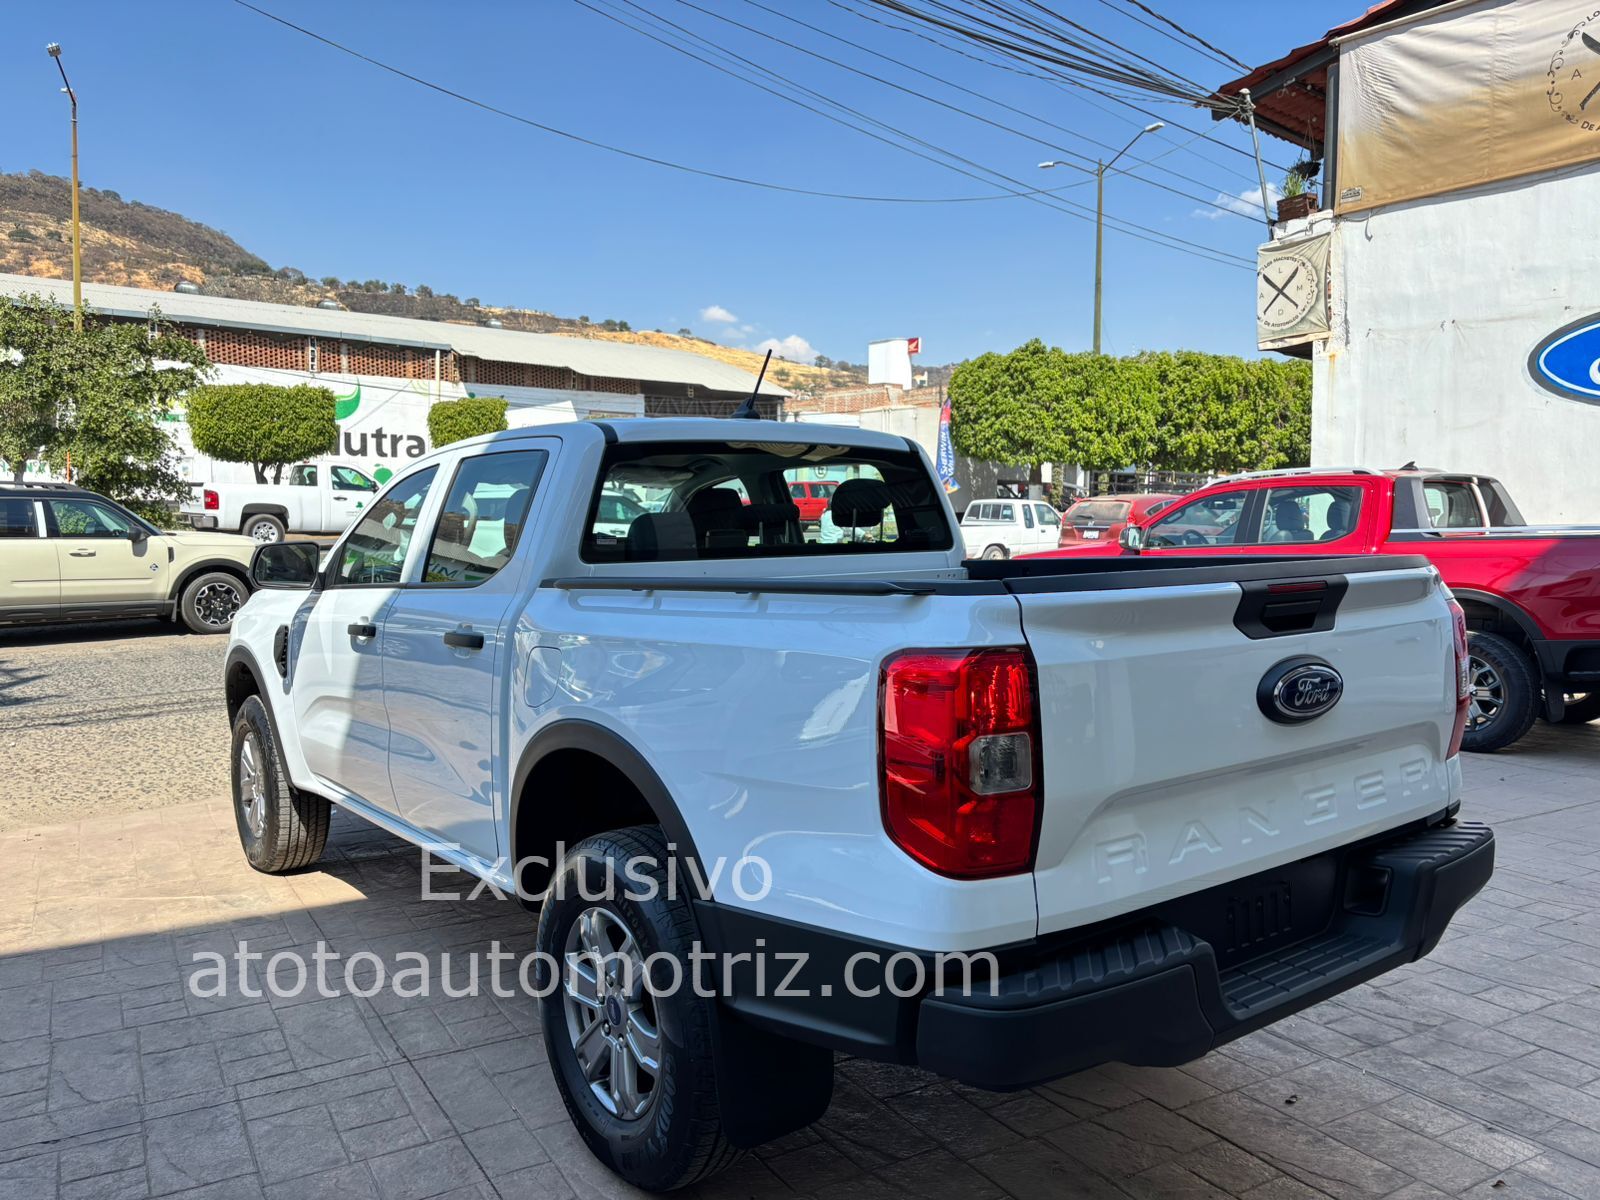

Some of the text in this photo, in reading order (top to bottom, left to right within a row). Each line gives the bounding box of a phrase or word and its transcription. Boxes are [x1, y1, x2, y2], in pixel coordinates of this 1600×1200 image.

[1571, 68, 1582, 81] A
[1294, 677, 1330, 706] Ford
[1094, 757, 1431, 884] RANGER
